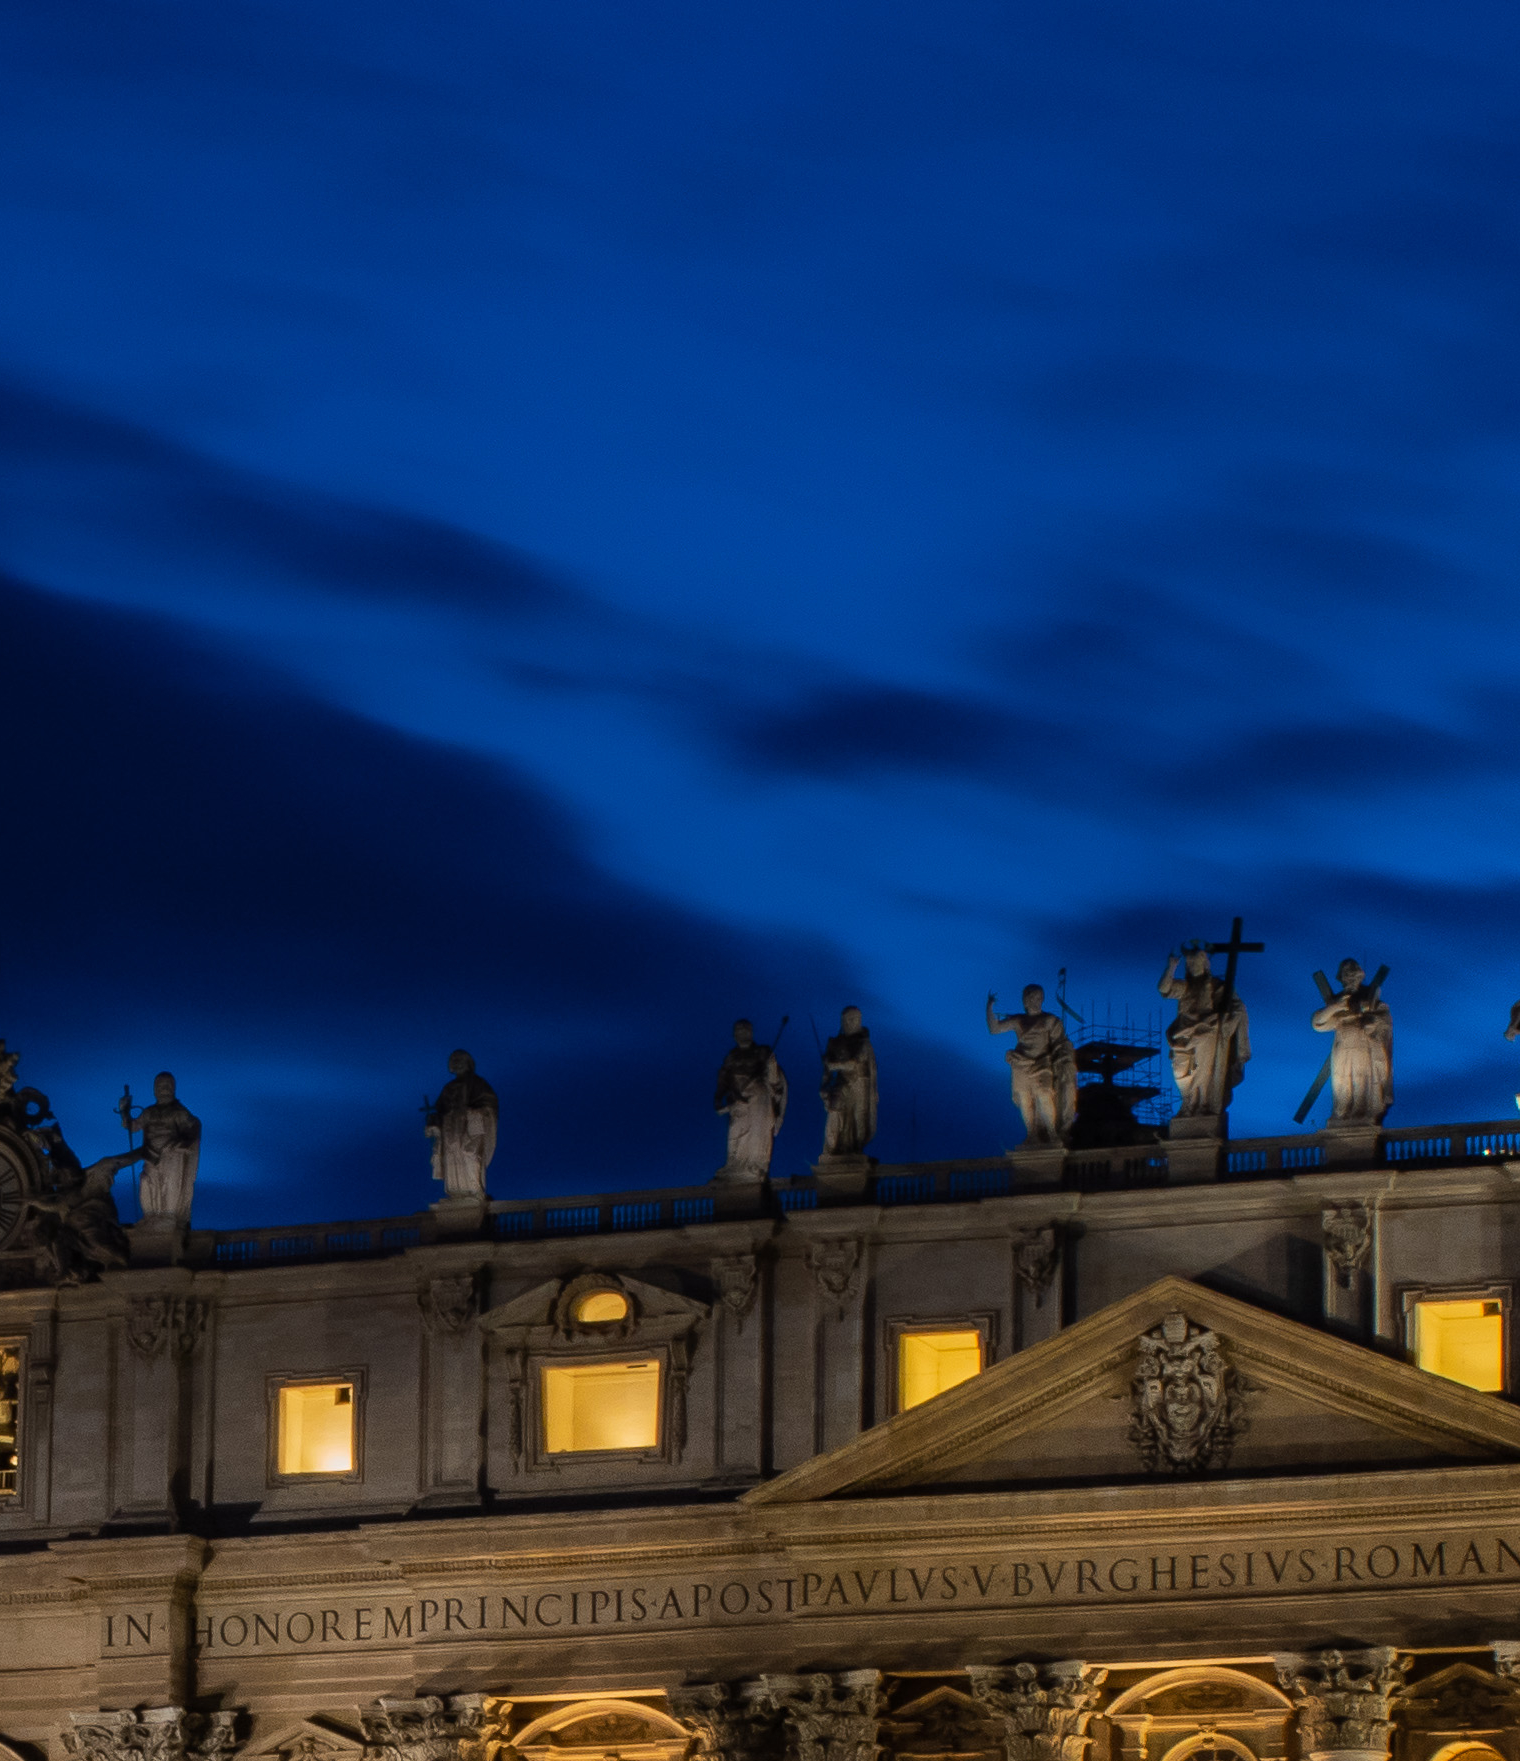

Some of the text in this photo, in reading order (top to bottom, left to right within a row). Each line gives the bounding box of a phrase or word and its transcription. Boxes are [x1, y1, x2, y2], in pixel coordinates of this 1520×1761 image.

[105, 1612, 153, 1647] IN
[190, 1605, 414, 1648] HONOREM
[418, 1587, 648, 1632] PRINCIPIS
[655, 1578, 798, 1620] APOST
[800, 1565, 958, 1606] PAVLVS
[968, 1564, 1000, 1597] V
[1011, 1549, 1316, 1597] BVRGHESIVS
